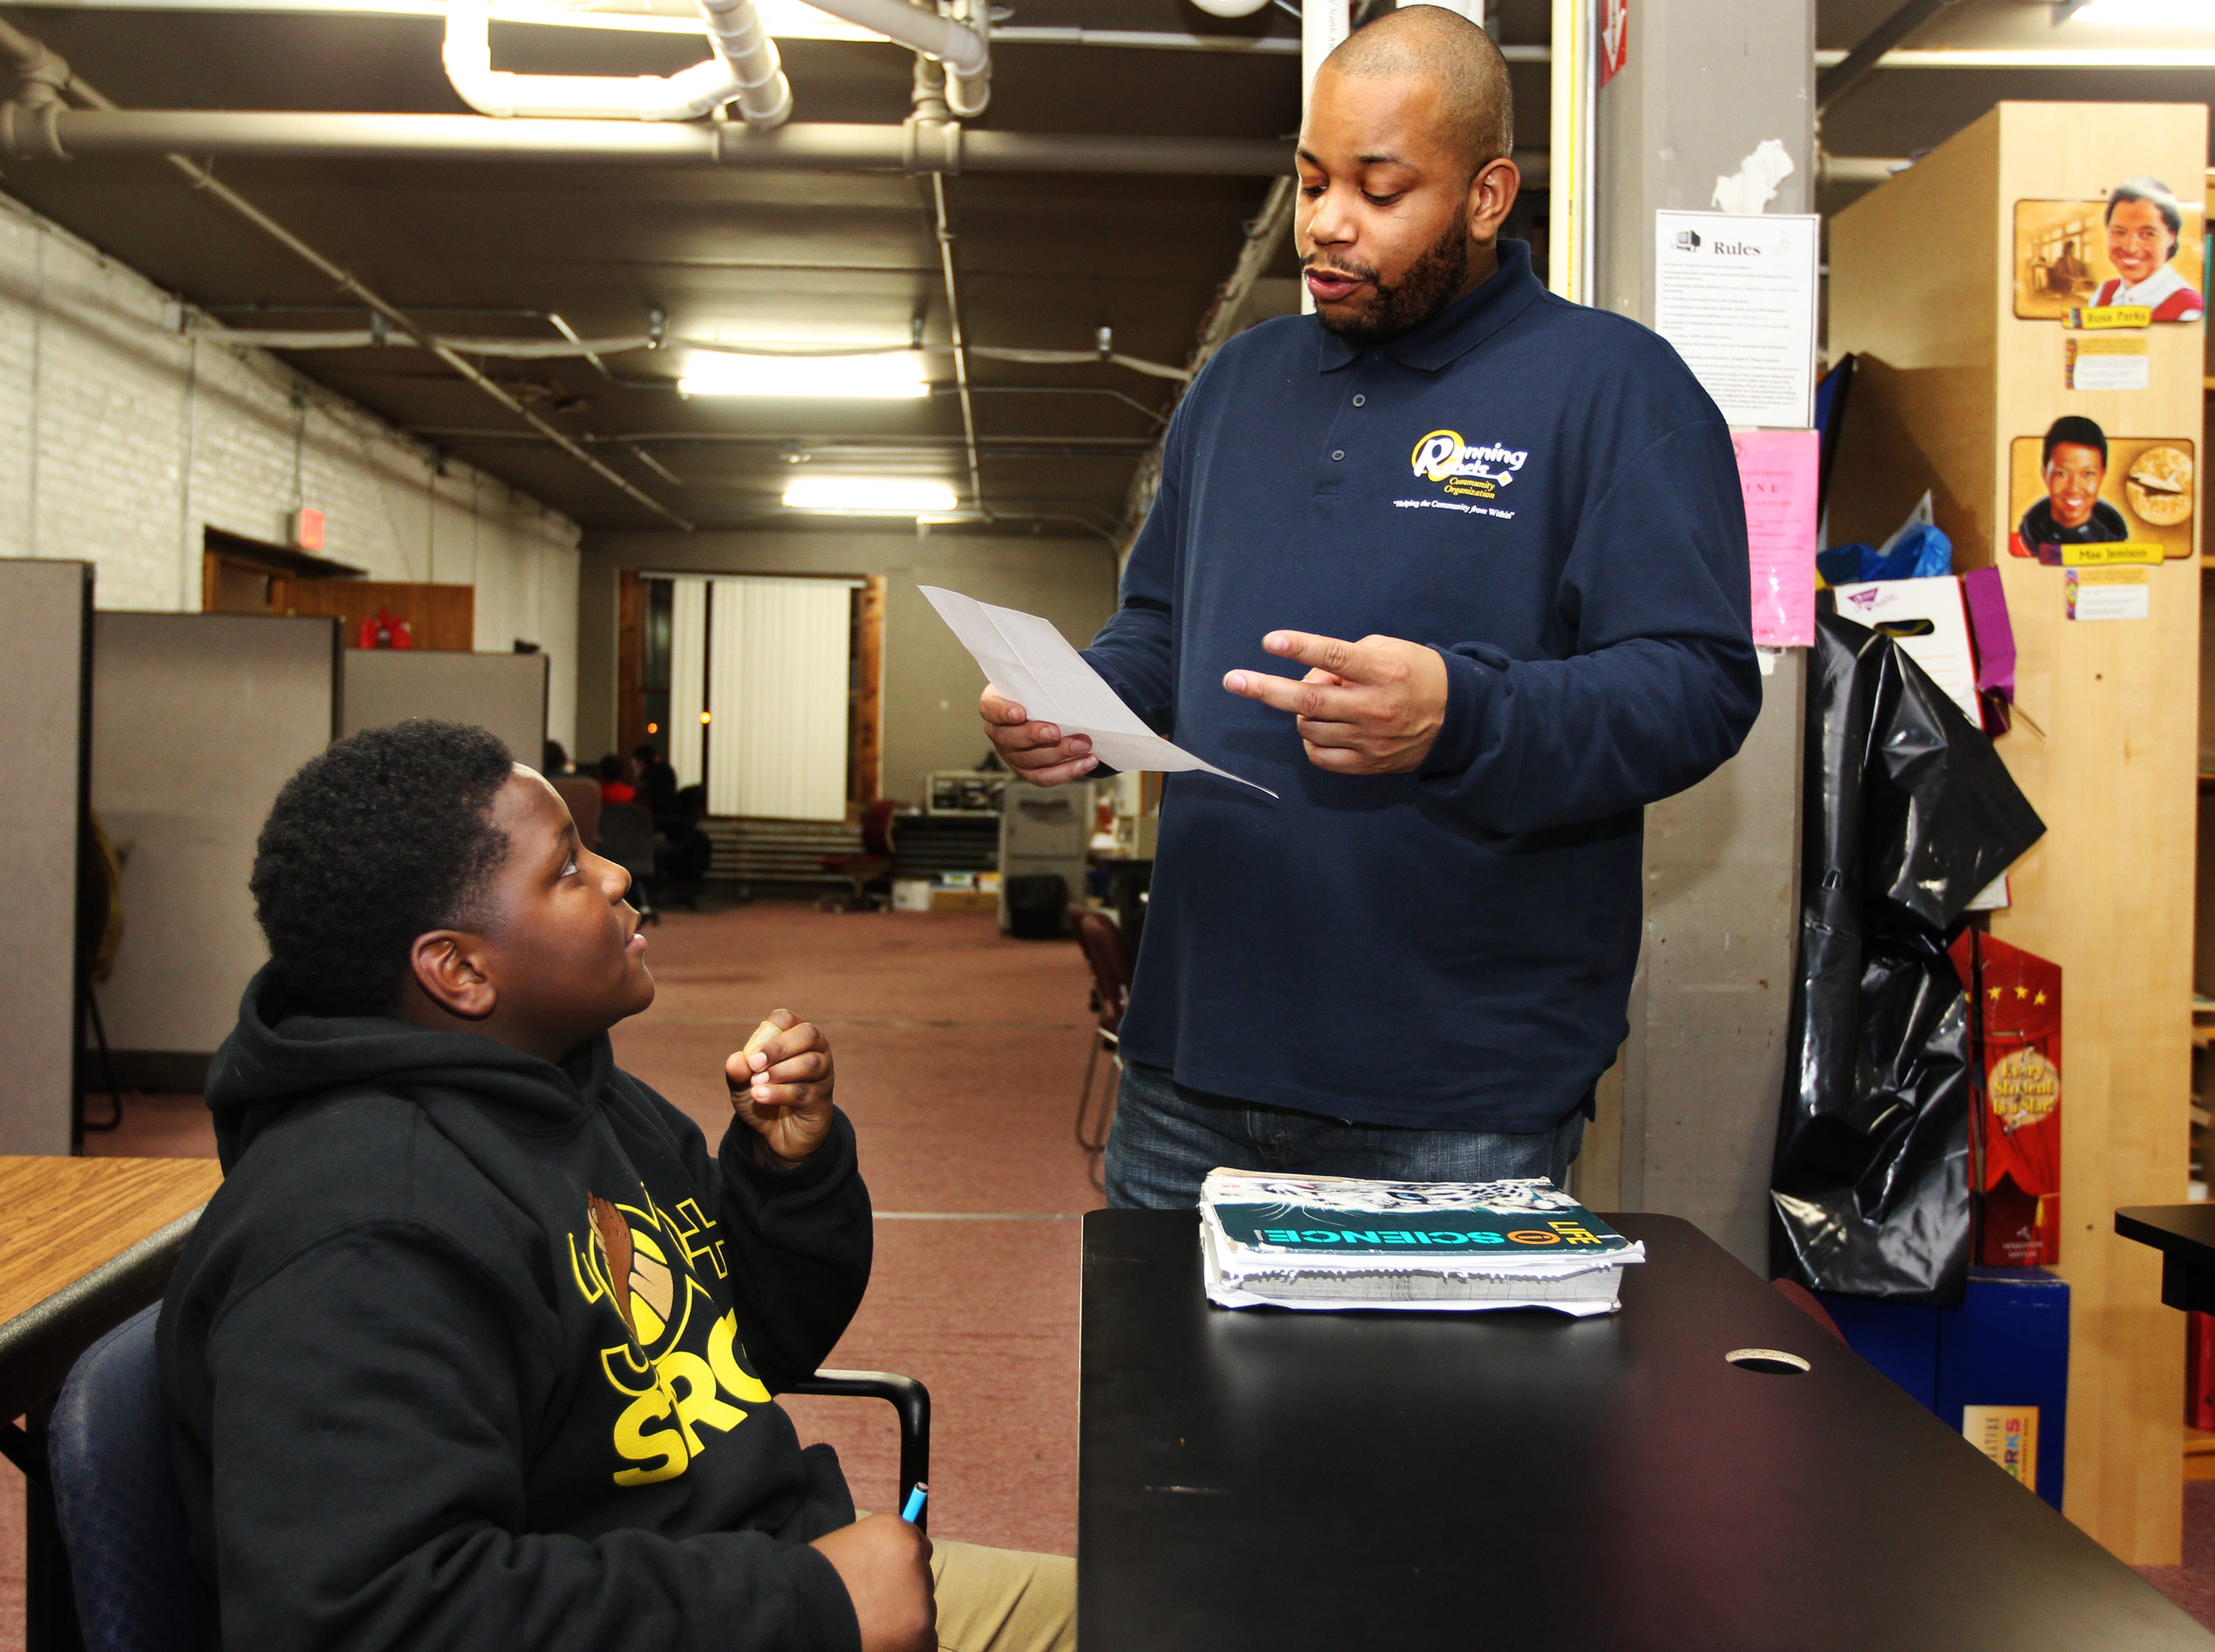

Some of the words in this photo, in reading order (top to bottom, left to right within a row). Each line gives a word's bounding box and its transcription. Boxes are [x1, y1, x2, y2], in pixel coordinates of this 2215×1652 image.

[1713, 241, 1761, 256] Rules
[2087, 314, 2112, 323] Rosa
[2116, 309, 2146, 322] Parks
[1414, 438, 1528, 477] Running
[1444, 485, 1496, 499] Organization
[1449, 477, 1495, 492] Community
[1431, 500, 1470, 513] Community
[1468, 505, 1488, 514] from
[2079, 549, 2101, 559] Mae
[2106, 548, 2147, 559] Jemison
[2002, 1062, 2044, 1081] Every
[1993, 1080, 2054, 1095] Student
[2010, 1104, 2019, 1114] a
[1264, 1230, 1506, 1245] SCIENCE
[1547, 1222, 1603, 1245] LIFE
[2005, 1418, 2021, 1479] ORKS
